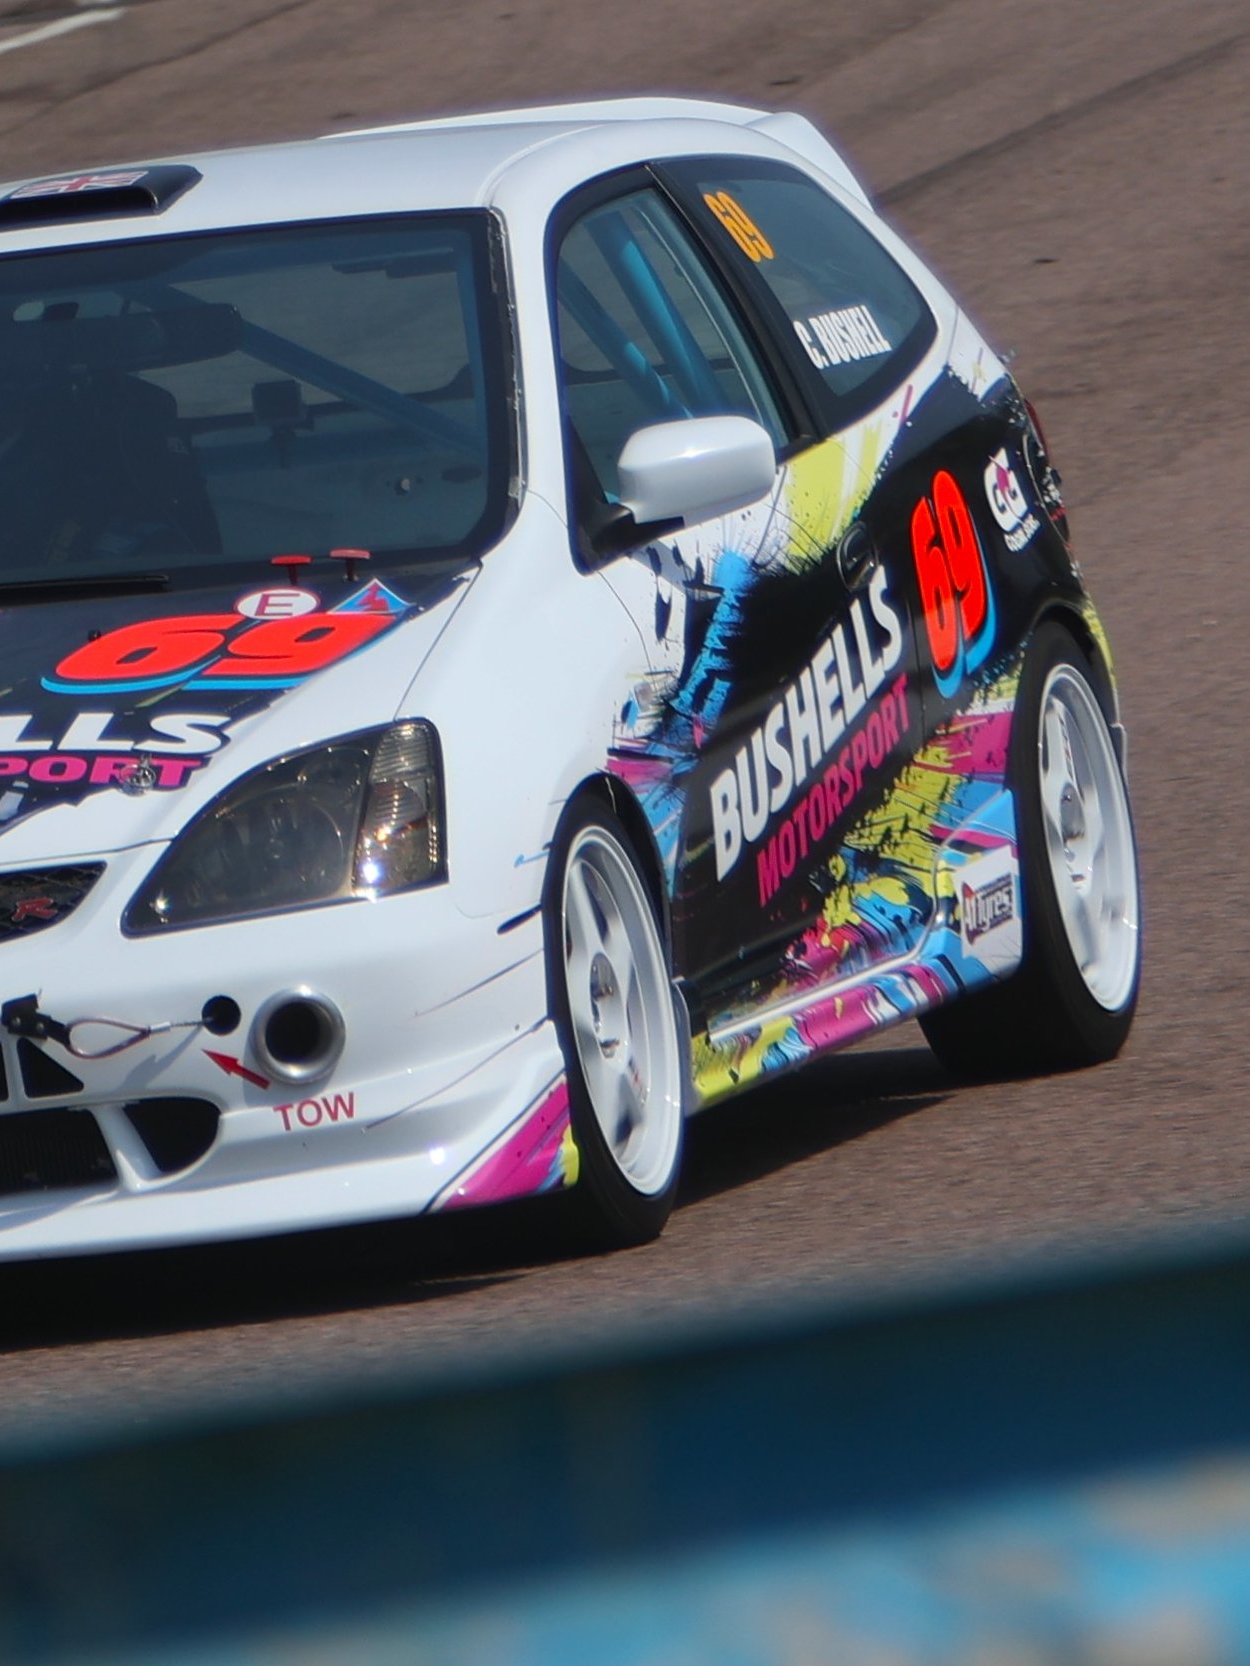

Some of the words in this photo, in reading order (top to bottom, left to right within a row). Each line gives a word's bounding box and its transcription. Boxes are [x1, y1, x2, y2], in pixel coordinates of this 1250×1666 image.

[703, 190, 774, 262] 69
[793, 320, 829, 369] C.
[808, 304, 892, 365] BUSHELL
[911, 470, 986, 671] 69
[254, 592, 301, 617] E
[55, 614, 397, 680] 69
[710, 566, 902, 882] BUSHELLS
[756, 675, 910, 907] MOTORSPORT
[272, 1091, 355, 1132] TOW
